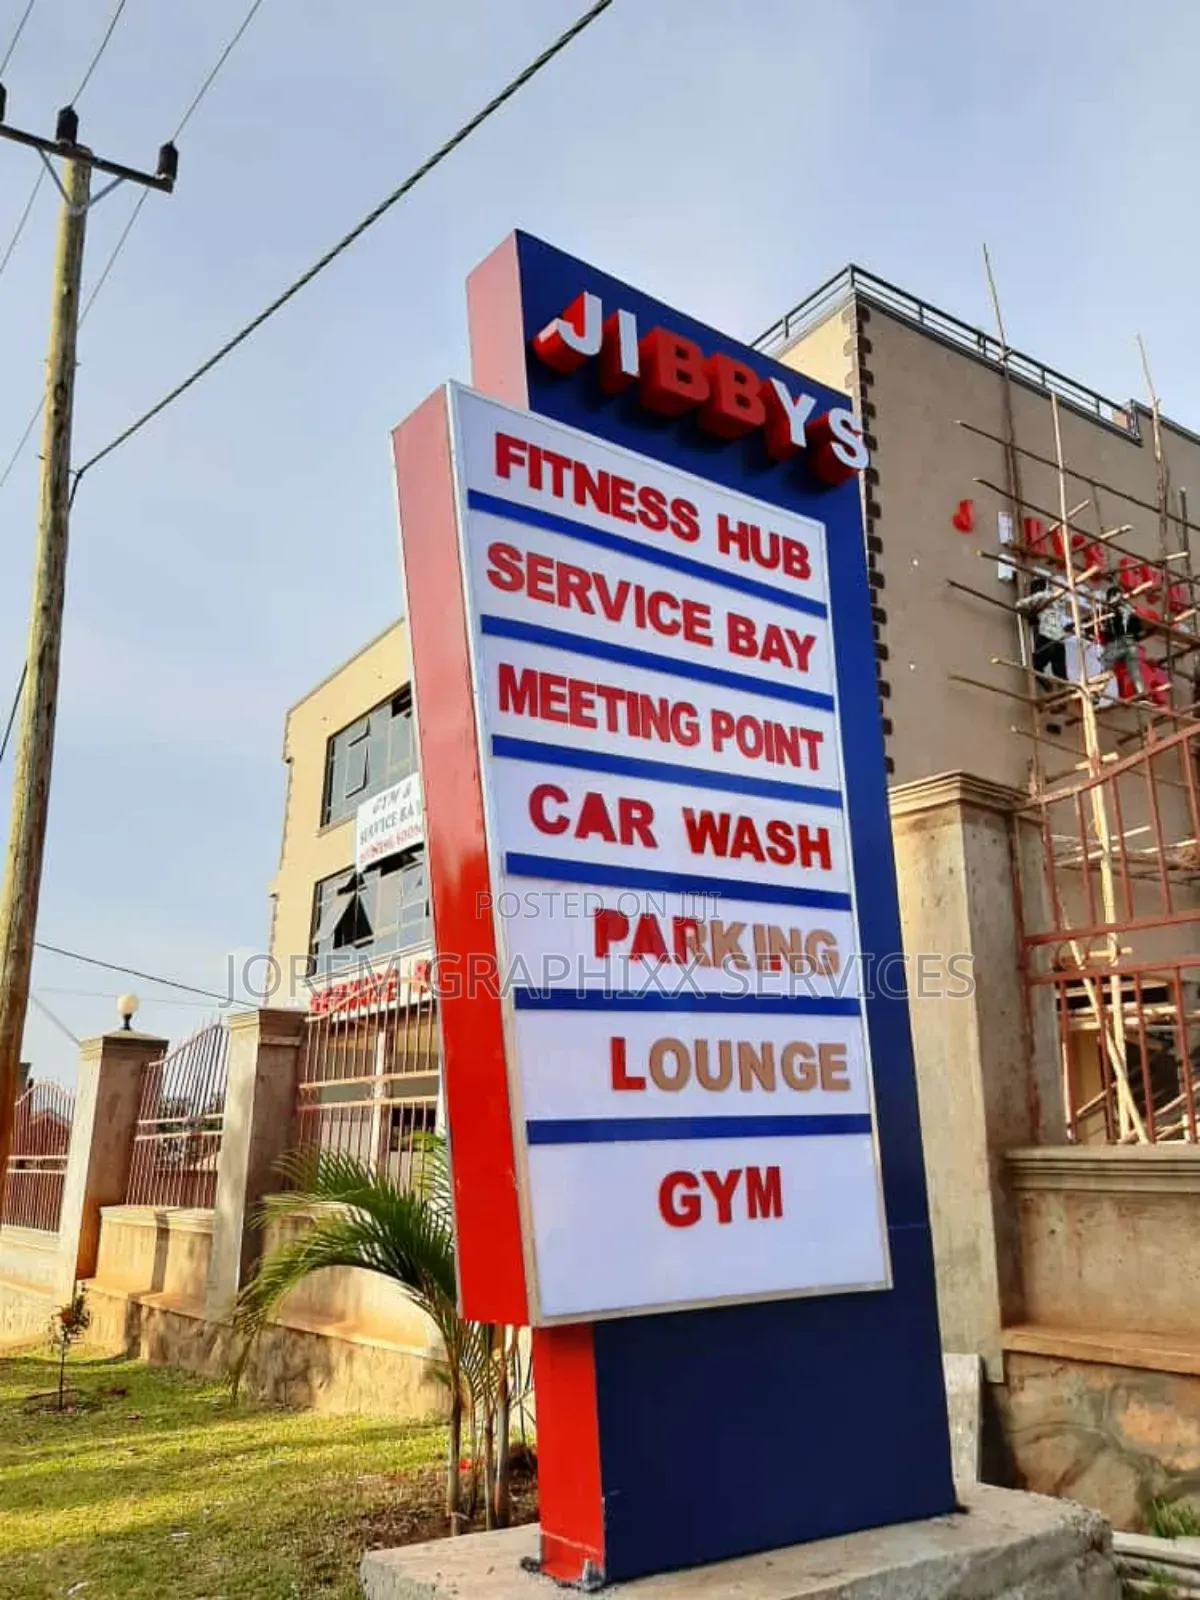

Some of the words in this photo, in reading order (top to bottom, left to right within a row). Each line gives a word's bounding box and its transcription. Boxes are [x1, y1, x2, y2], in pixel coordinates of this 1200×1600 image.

[533, 291, 869, 486] JIBBYS
[495, 432, 699, 543] FITNESS
[717, 513, 811, 580] HUB
[487, 541, 713, 646] SERVICE
[726, 612, 816, 672] BAY
[498, 664, 700, 747] MEETING
[711, 709, 824, 771] POINT
[528, 784, 659, 848] CAR
[682, 806, 832, 870] WASH
[593, 908, 840, 976] PARKING
[611, 1036, 850, 1092] LOUNGE
[658, 1166, 783, 1227] GYM
